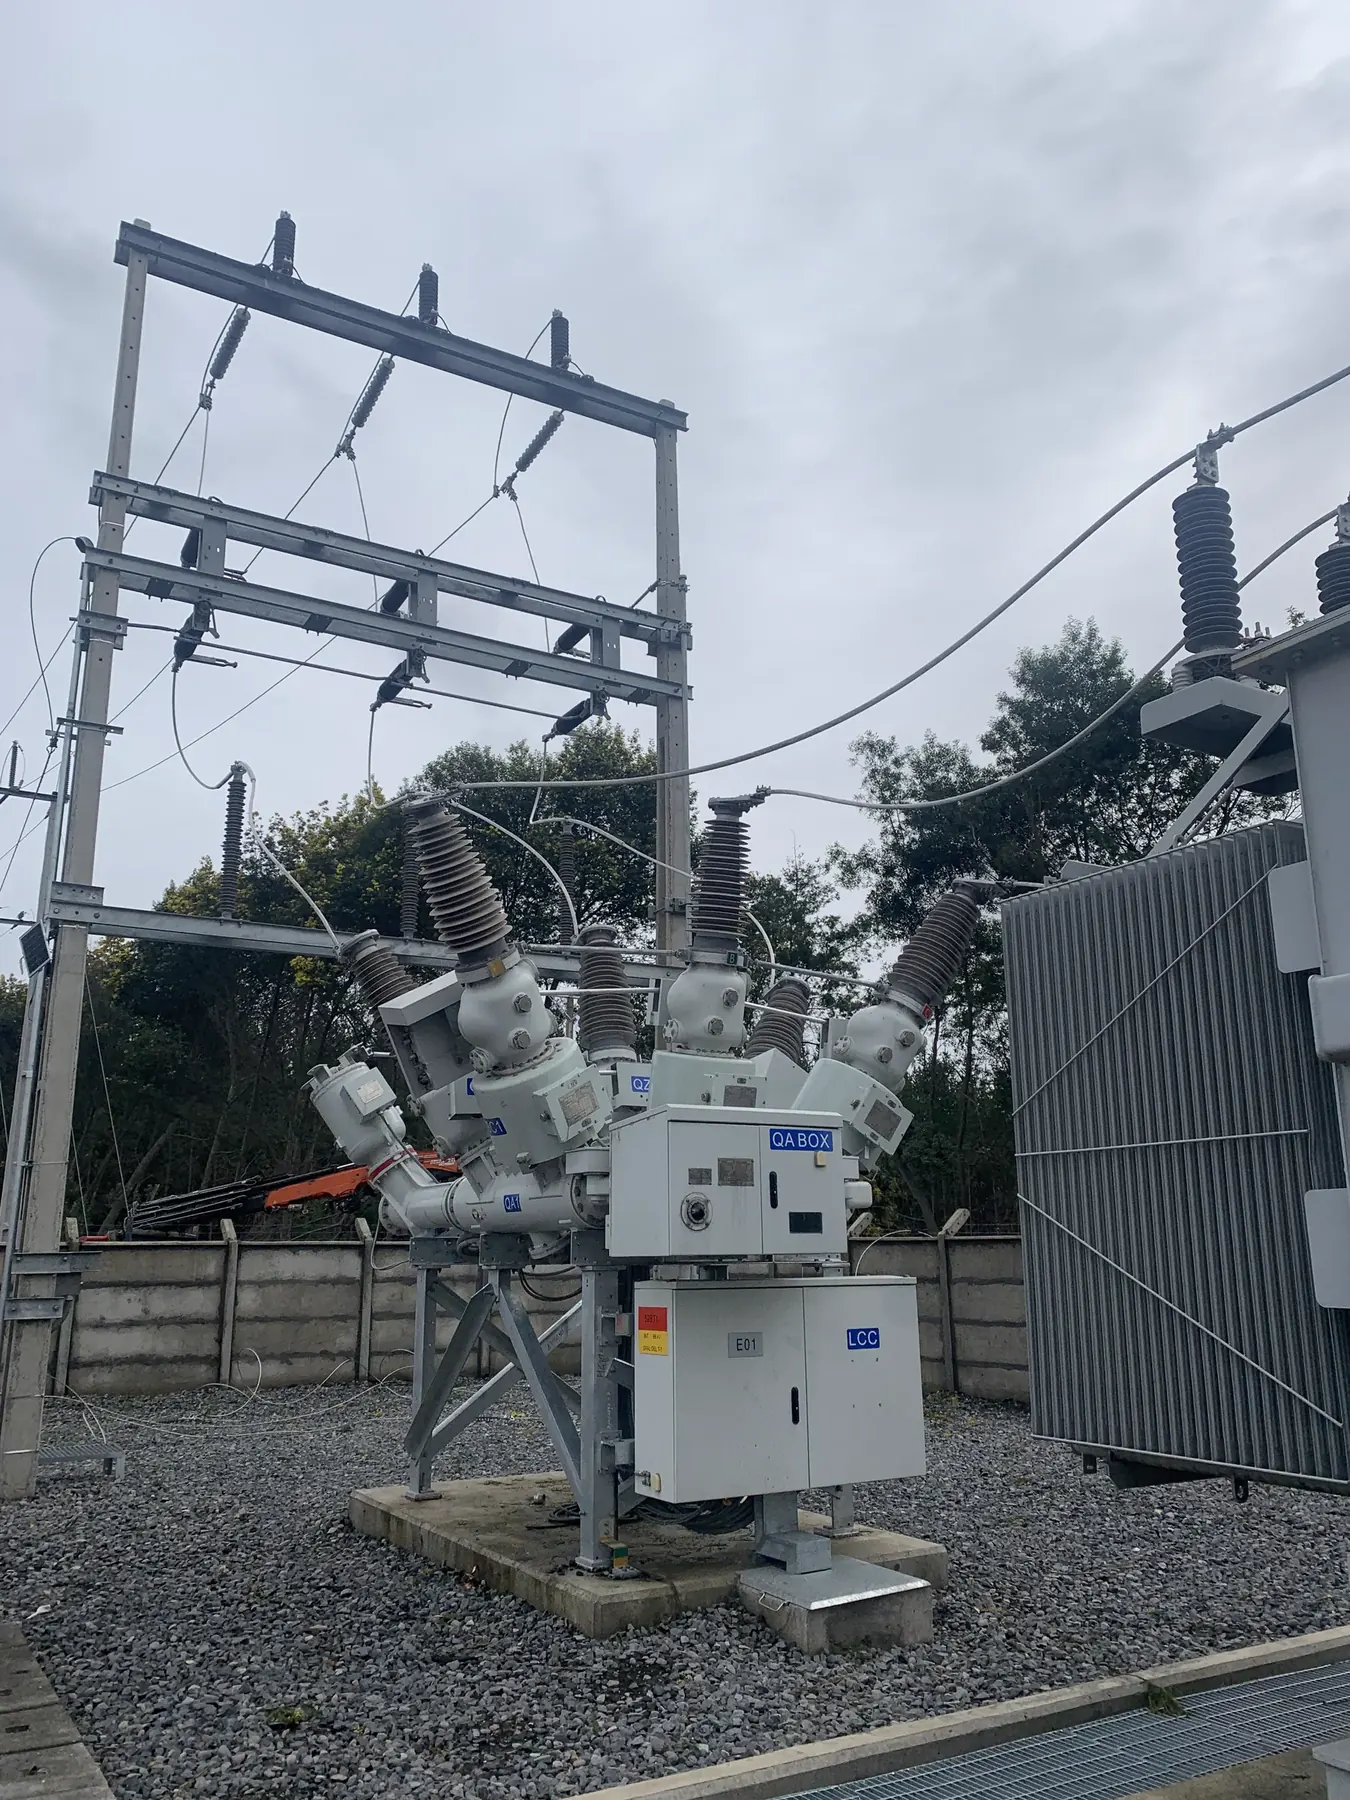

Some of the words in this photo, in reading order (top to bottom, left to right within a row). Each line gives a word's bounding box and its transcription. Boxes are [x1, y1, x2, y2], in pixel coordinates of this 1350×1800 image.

[488, 1120, 503, 1134] C1
[798, 1132, 830, 1149] BOX
[504, 1196, 520, 1210] QA1
[736, 1338, 756, 1351] E01
[848, 1330, 878, 1346] LCC
